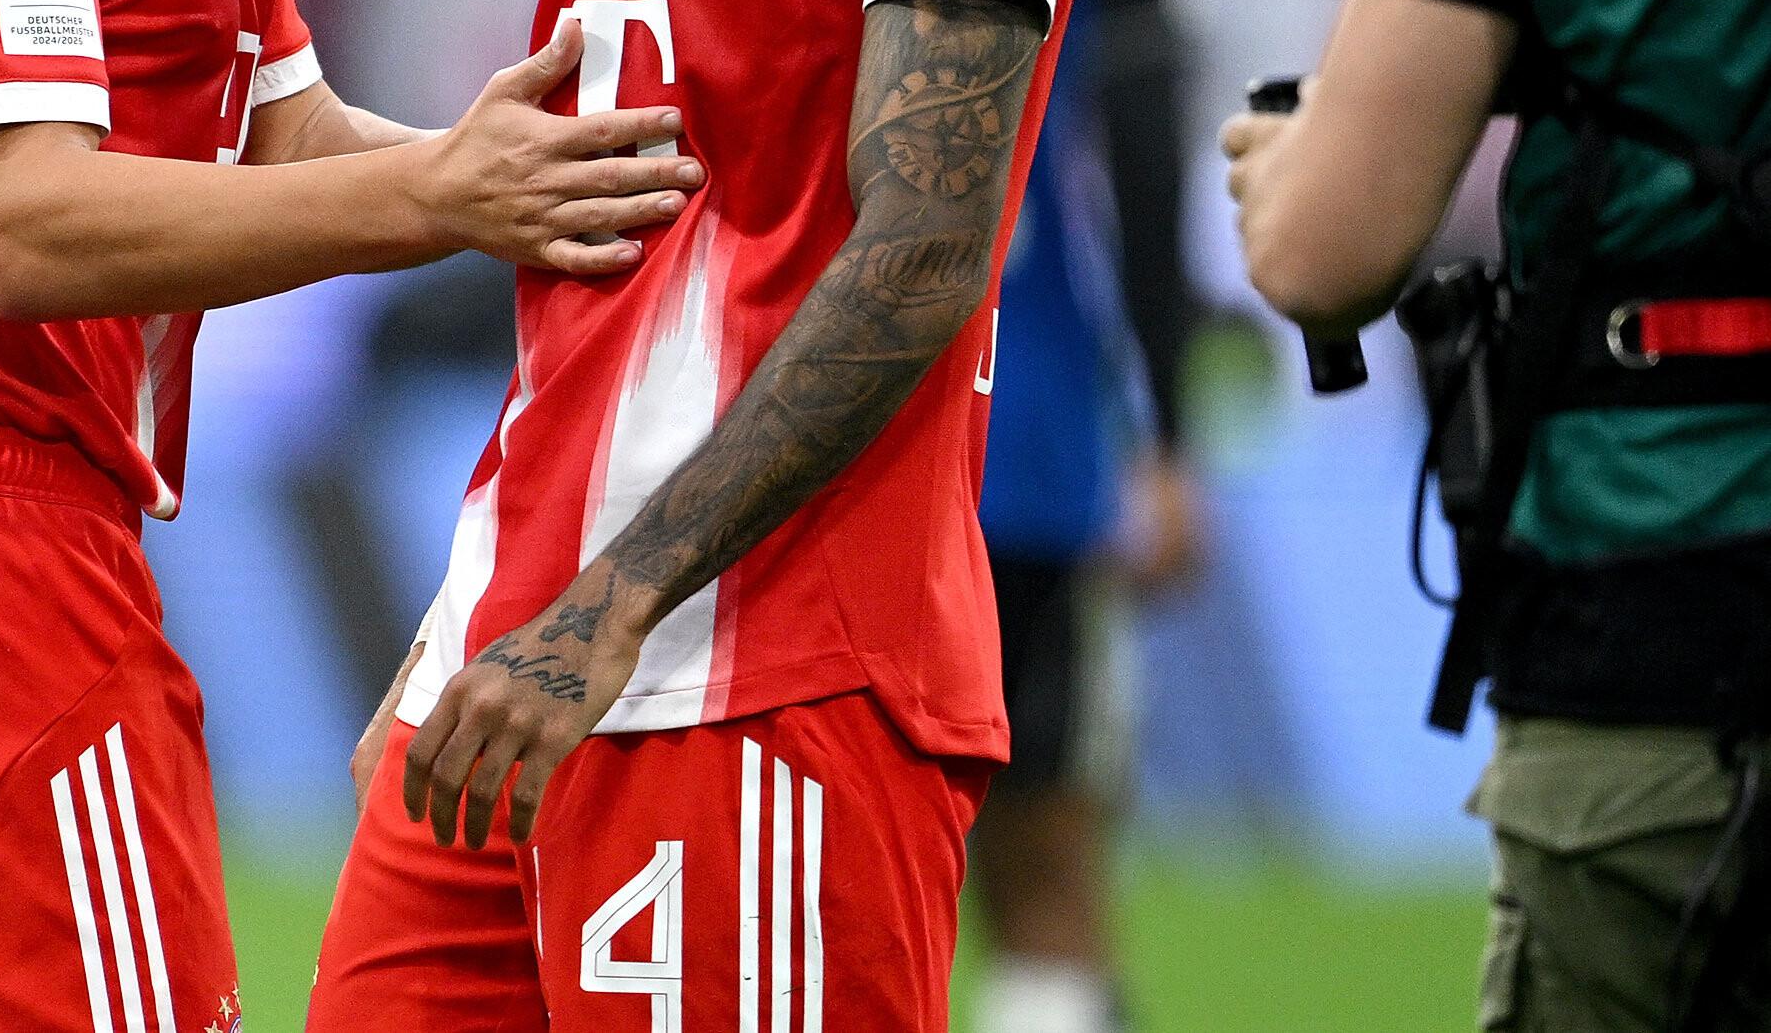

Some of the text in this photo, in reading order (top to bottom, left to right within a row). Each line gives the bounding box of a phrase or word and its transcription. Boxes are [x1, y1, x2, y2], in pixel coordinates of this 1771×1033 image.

[28, 16, 83, 25] DEUTSCHER
[11, 26, 94, 37] FUSSBALLMEISTER
[32, 36, 83, 45] 2024/2025
[580, 840, 684, 1033] 4
